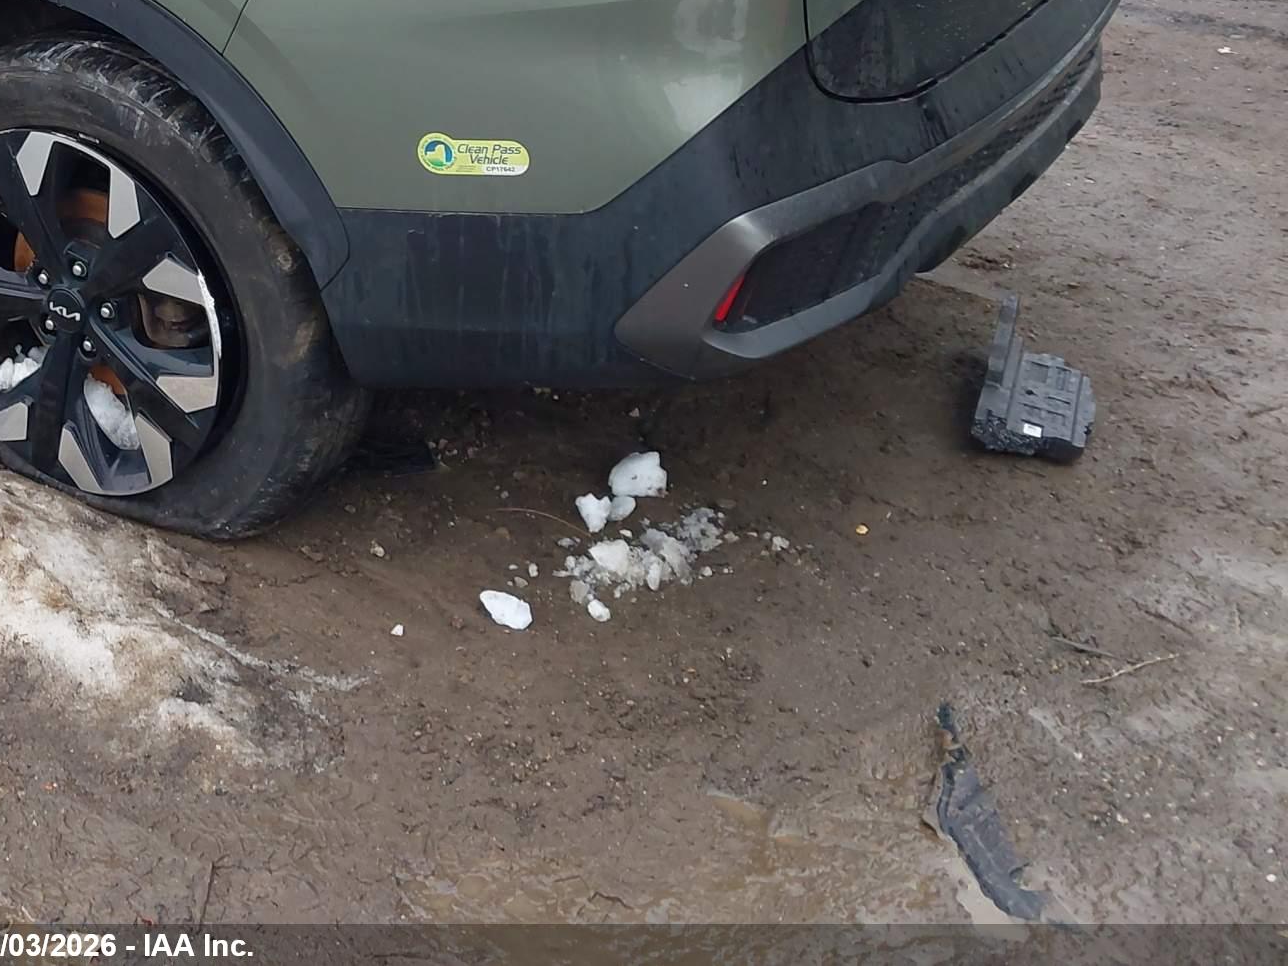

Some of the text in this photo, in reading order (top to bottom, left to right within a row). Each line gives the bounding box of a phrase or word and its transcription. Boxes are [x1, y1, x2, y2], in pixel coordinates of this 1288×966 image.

[457, 143, 521, 155] Clean Pass
[470, 154, 509, 165] Vehicle
